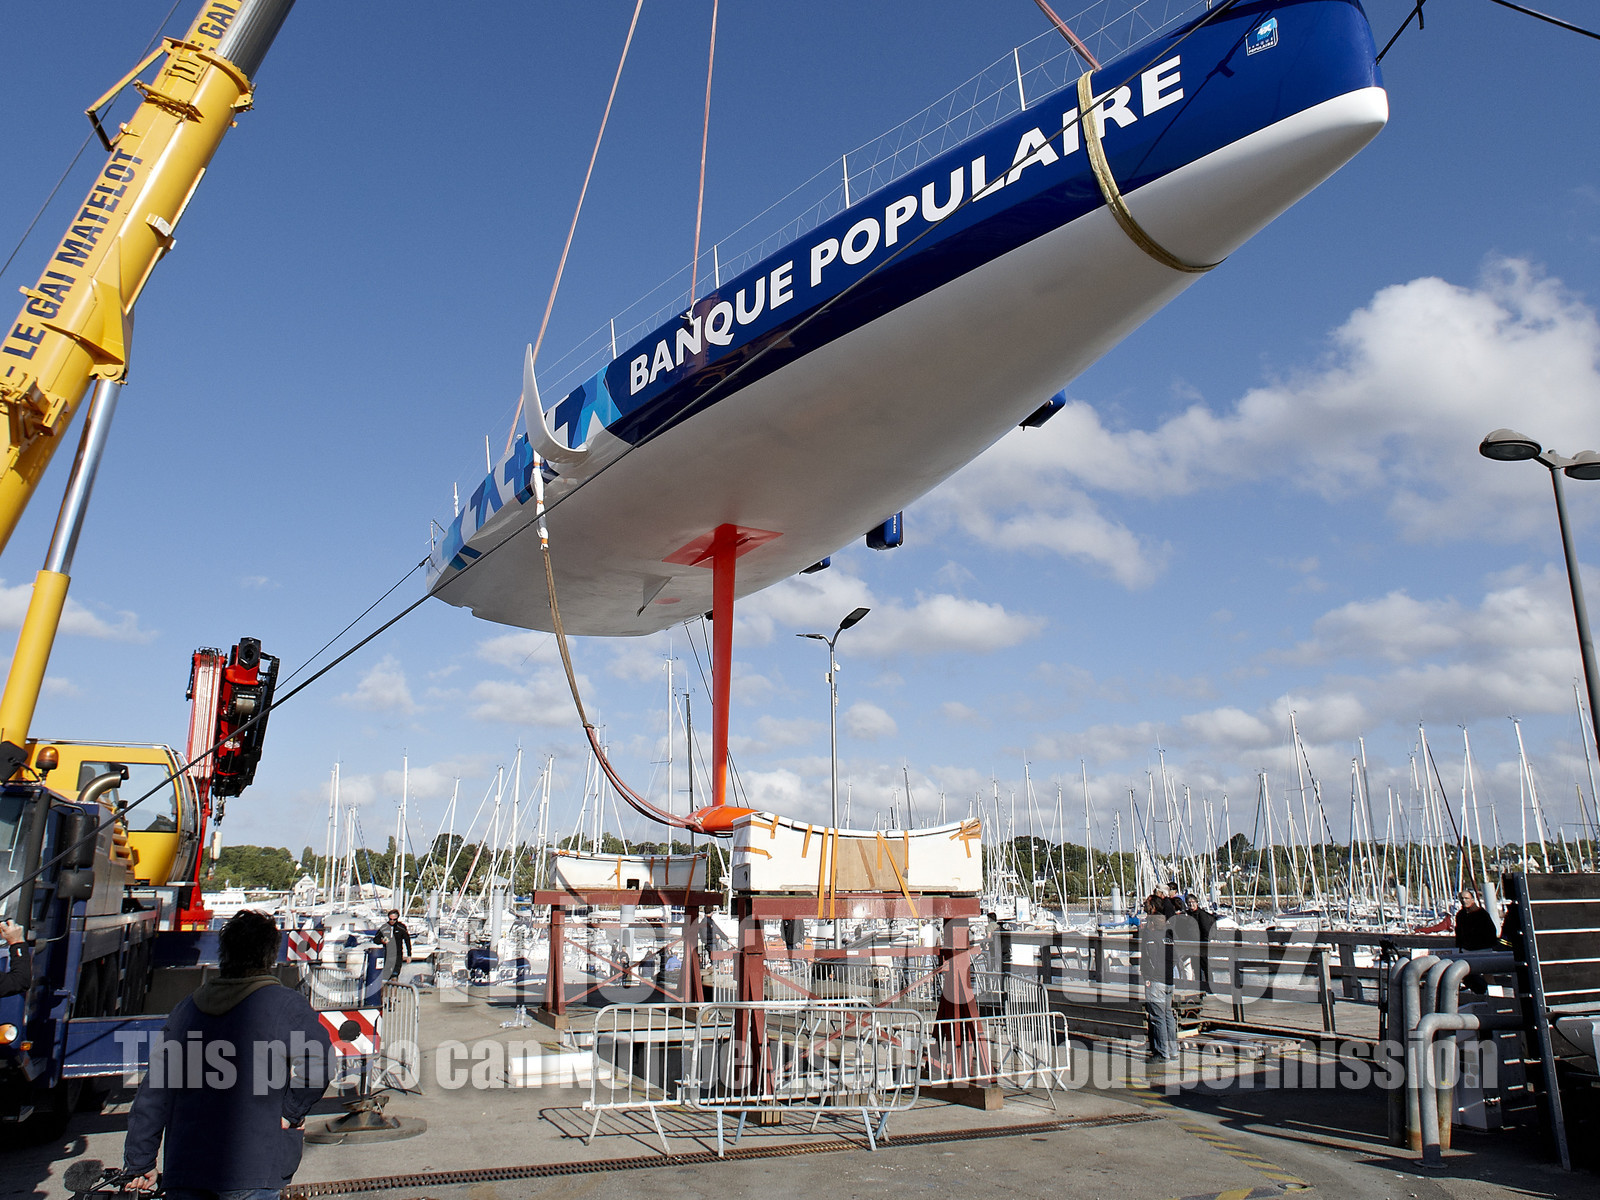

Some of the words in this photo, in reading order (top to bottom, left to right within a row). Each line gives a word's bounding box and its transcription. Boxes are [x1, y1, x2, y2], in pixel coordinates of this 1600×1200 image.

[197, 2, 237, 39] GAI
[3, 323, 46, 360] LE
[26, 271, 74, 319] GAI
[55, 148, 143, 269] MATELOT
[630, 260, 793, 396] BANQUE
[809, 54, 1185, 287] POPULAIRE
